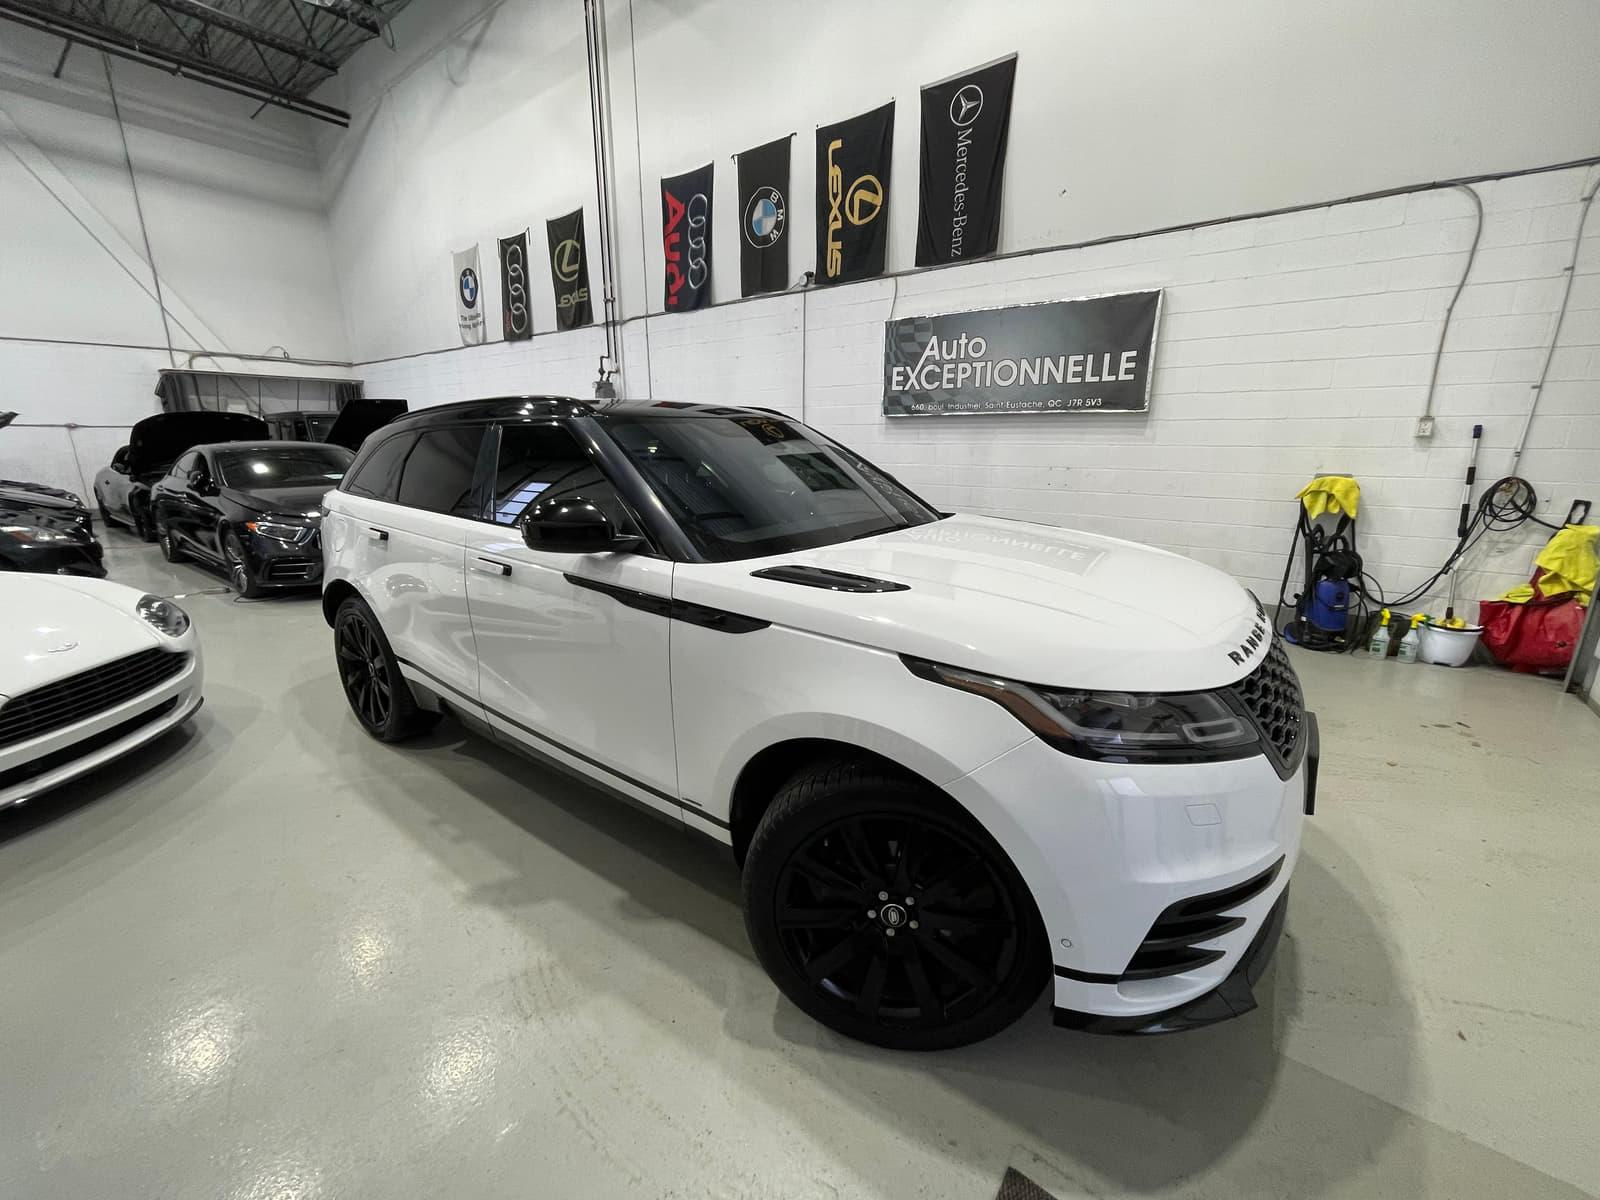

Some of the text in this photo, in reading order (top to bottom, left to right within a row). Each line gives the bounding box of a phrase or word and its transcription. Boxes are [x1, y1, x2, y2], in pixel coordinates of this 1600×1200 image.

[827, 139, 842, 279] LEXUS
[951, 128, 973, 257] Mercedes-Benz
[922, 332, 987, 361] Auto
[891, 350, 1138, 391] EXCEPTIONNELLE
[1047, 399, 1062, 408] QC
[1067, 399, 1083, 407] J7R
[1085, 398, 1102, 407] 5V3
[1227, 622, 1266, 666] RANGE
